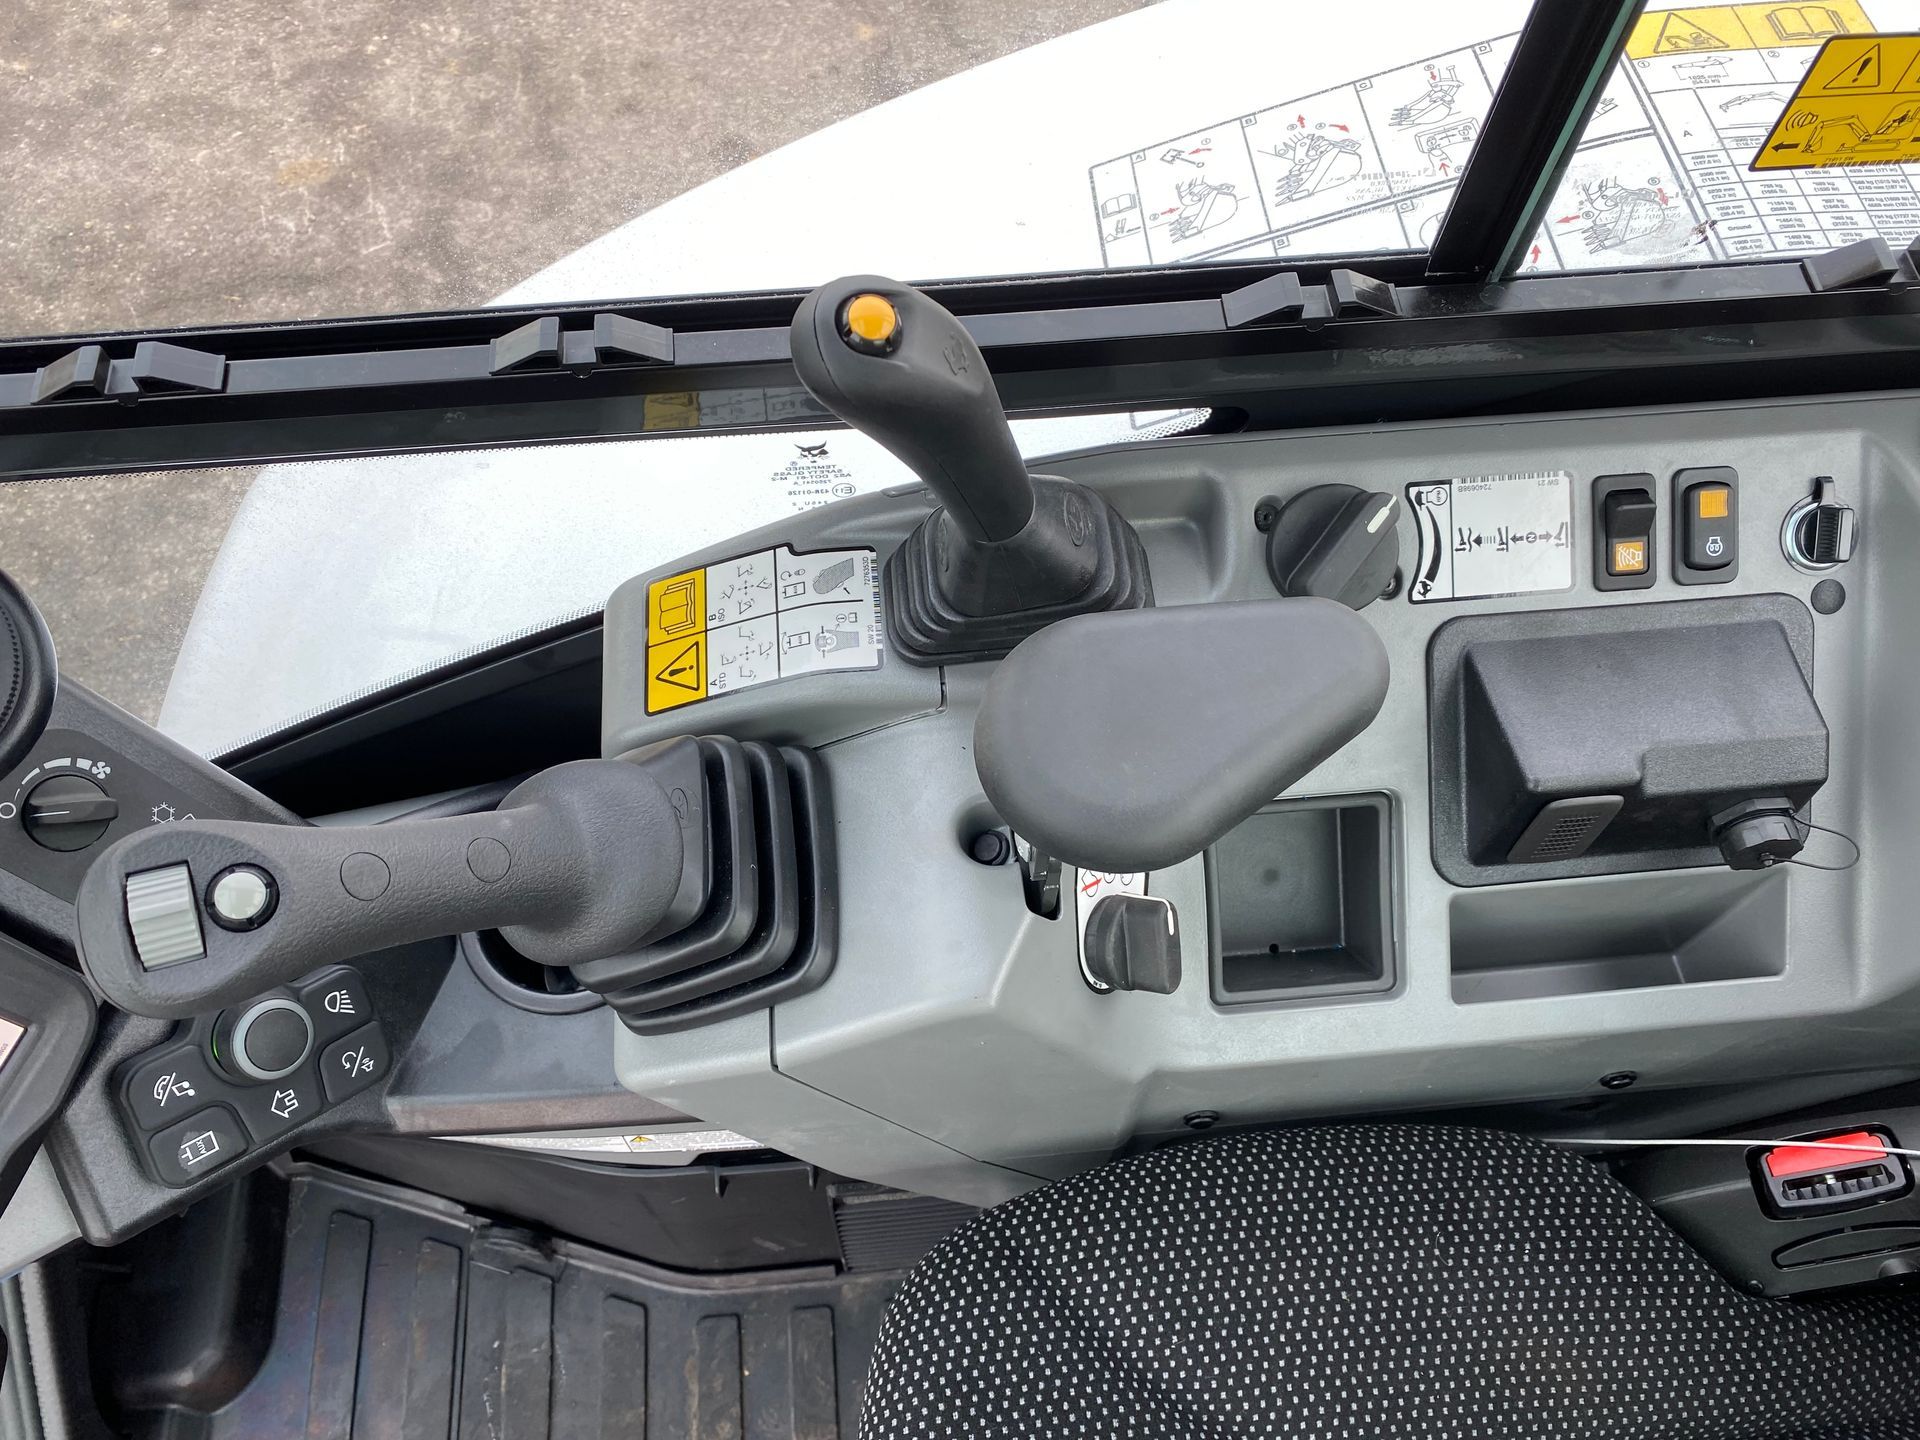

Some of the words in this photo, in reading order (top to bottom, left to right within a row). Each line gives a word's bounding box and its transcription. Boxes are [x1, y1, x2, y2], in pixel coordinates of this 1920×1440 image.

[1549, 478, 1559, 486] SW
[708, 613, 717, 622] B
[717, 608, 726, 622] ISO
[867, 624, 874, 633] 20
[868, 634, 875, 645] SW
[709, 679, 718, 687] A
[719, 672, 727, 689] STD
[196, 1139, 207, 1154] AUX
